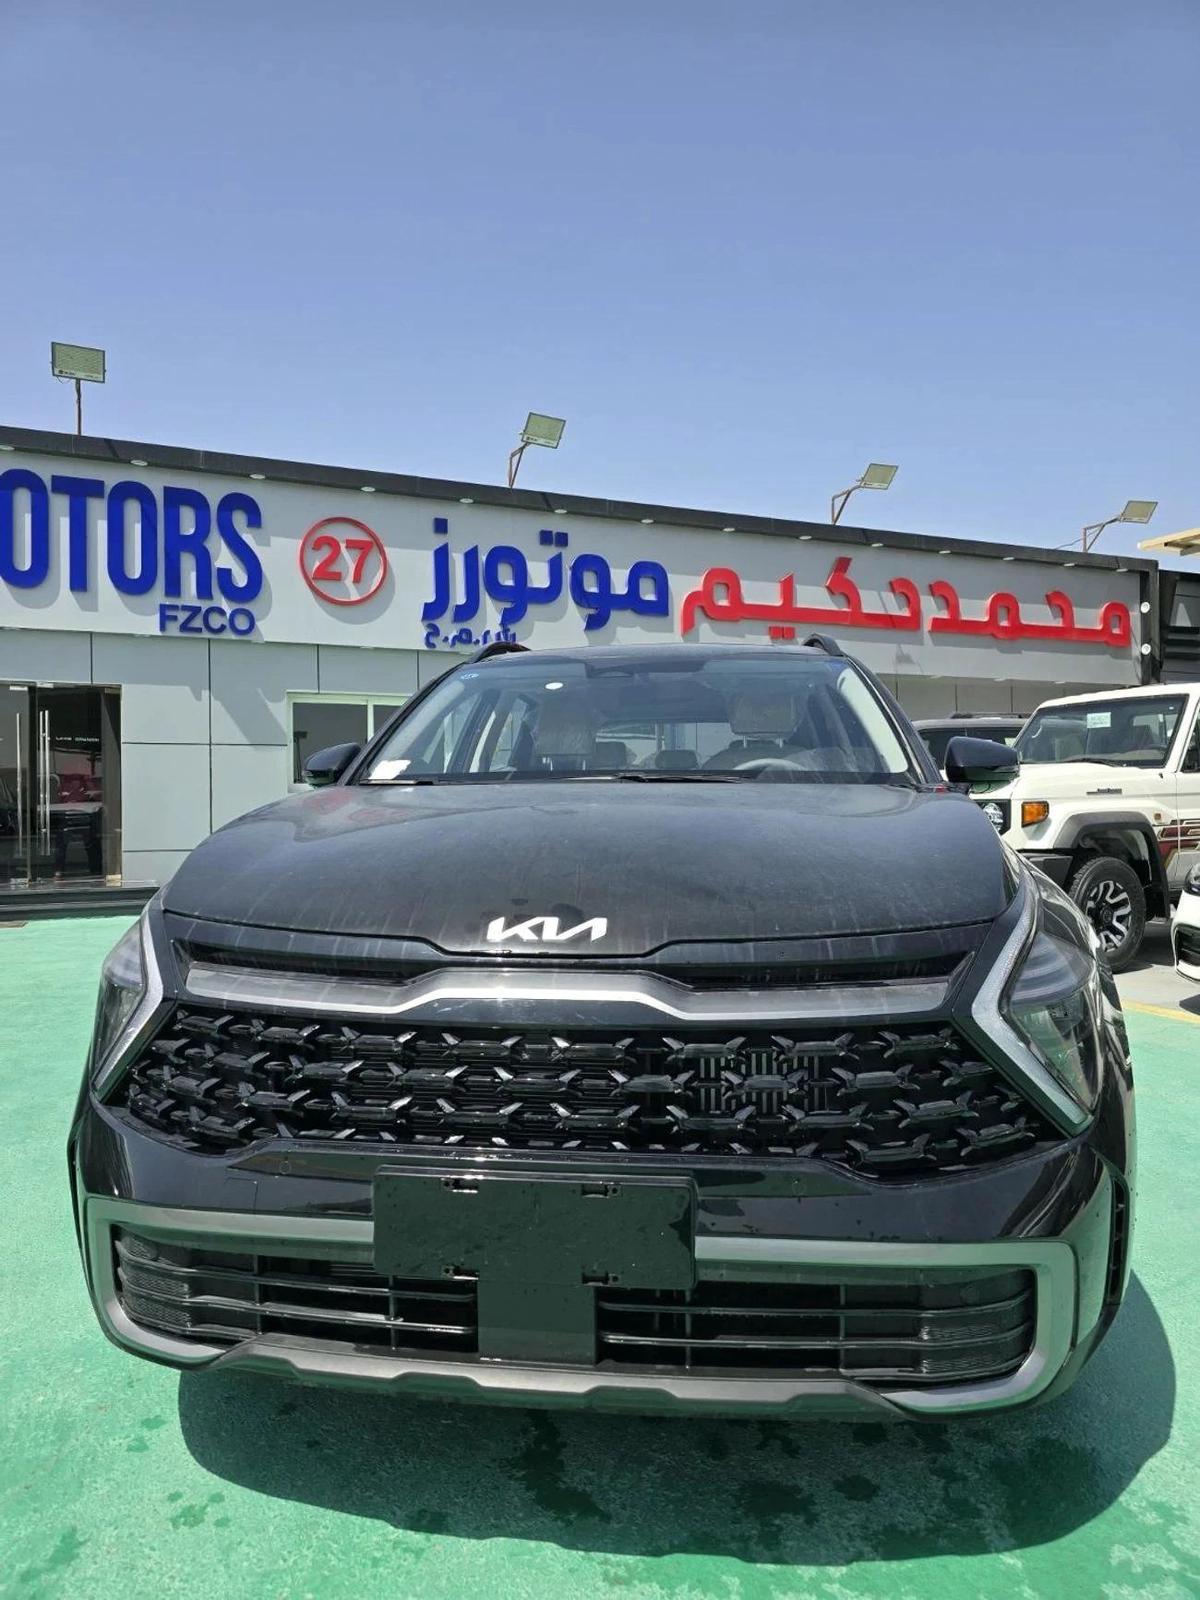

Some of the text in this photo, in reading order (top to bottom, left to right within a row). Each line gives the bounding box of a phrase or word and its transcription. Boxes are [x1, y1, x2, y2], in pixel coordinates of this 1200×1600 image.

[0, 468, 263, 603] OTORS
[311, 535, 374, 583] 27
[421, 517, 1131, 647] محمد حكيم موتورز
[159, 603, 256, 636] FZCO
[487, 916, 608, 943] KIA
